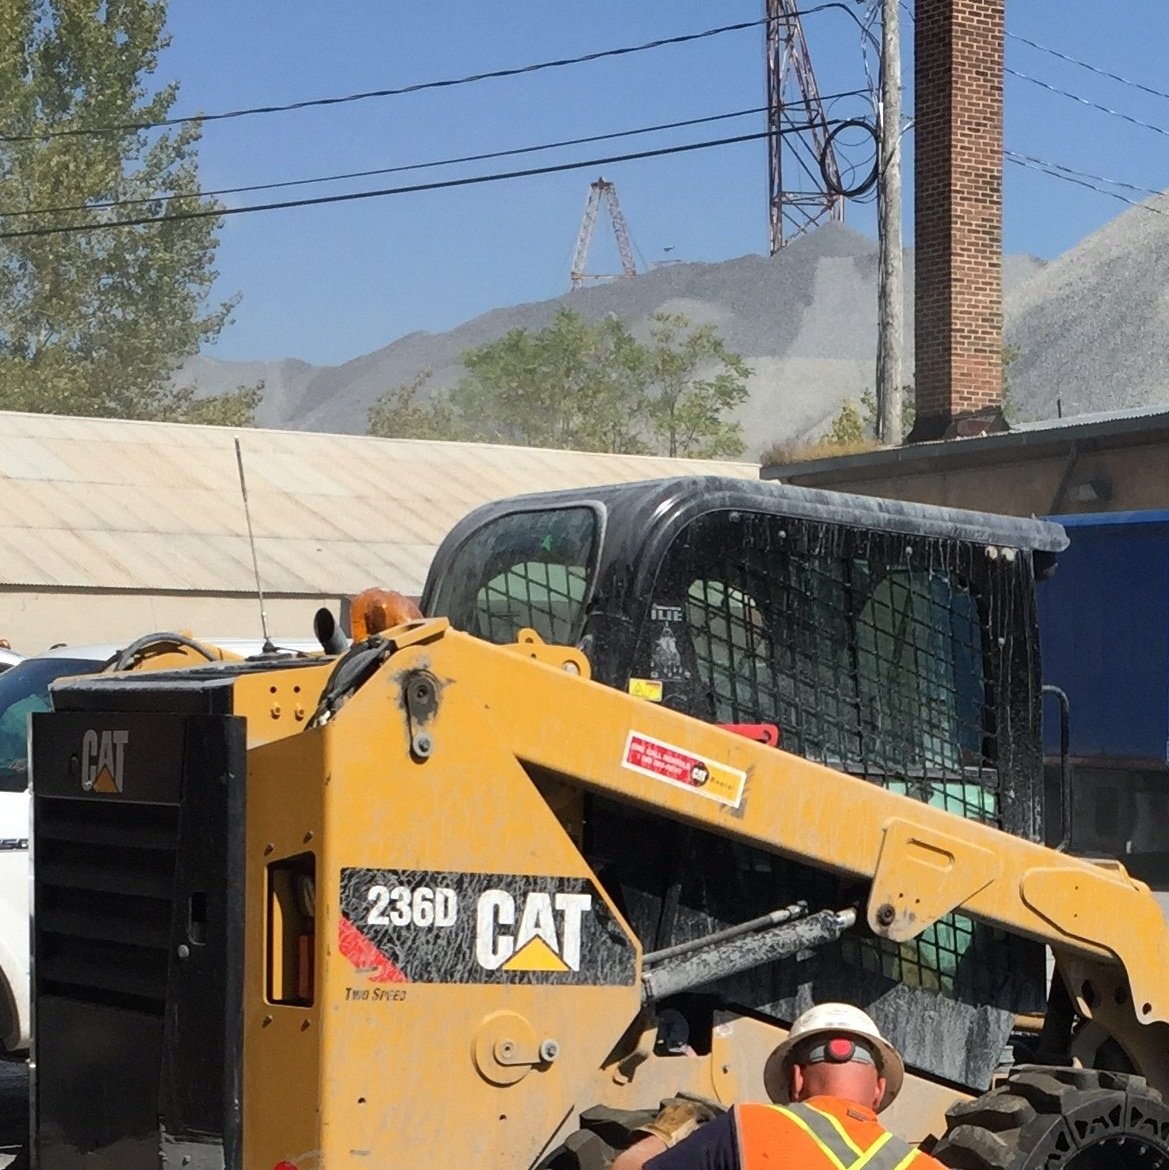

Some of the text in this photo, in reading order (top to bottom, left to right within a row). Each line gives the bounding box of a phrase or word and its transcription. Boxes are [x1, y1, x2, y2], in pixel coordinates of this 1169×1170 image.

[82, 729, 129, 793] CAT
[367, 885, 592, 972] 236D CAT
